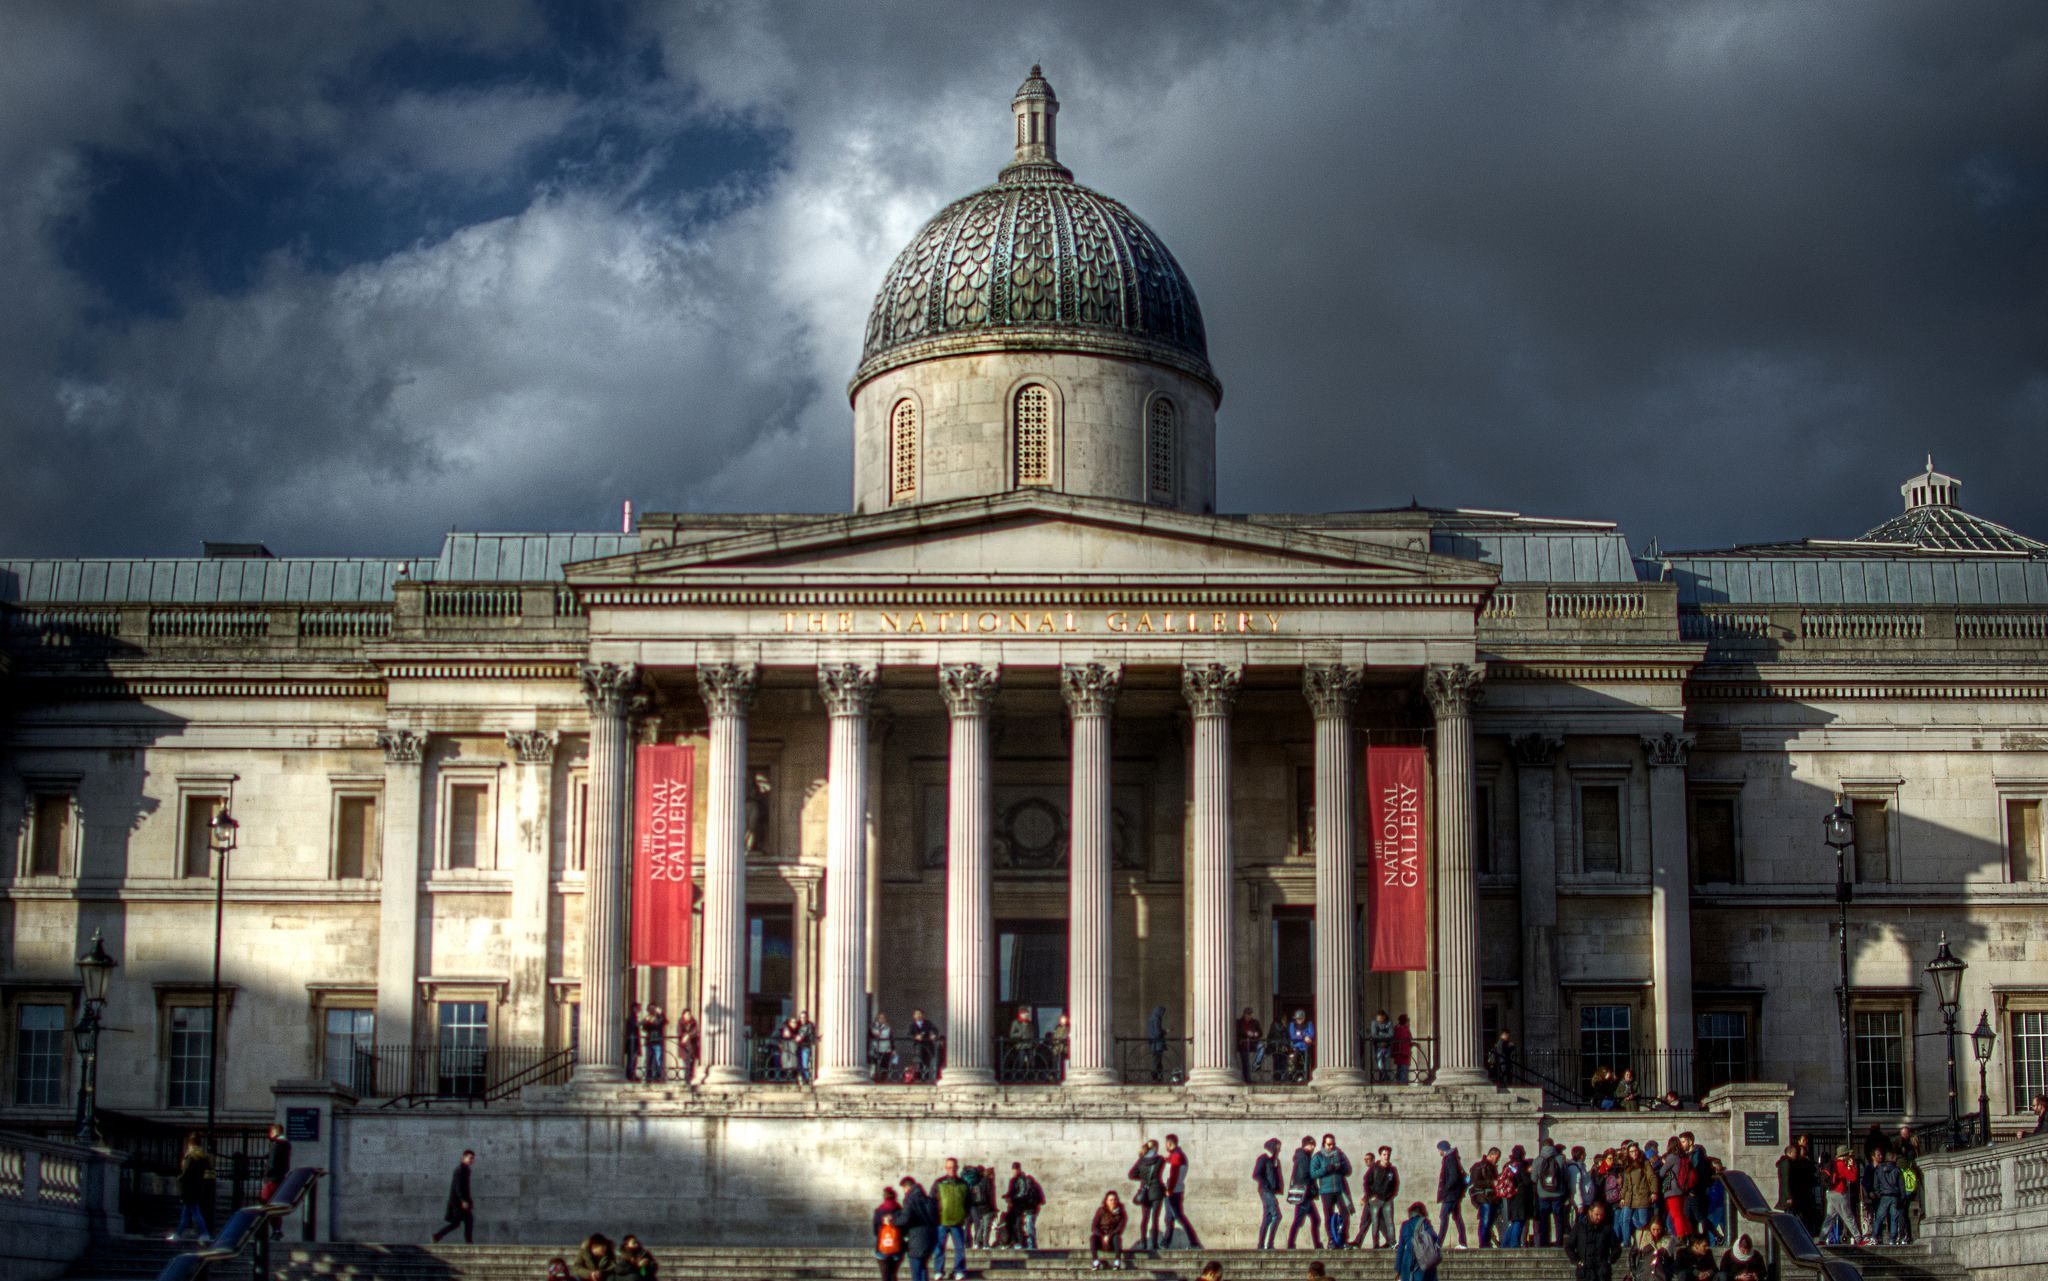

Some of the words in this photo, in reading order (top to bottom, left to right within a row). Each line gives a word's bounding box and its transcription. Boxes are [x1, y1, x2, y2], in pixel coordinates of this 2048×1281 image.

[779, 611, 854, 633] THE
[880, 611, 1081, 633] NATIONAL
[1106, 611, 1285, 633] GALLERY
[642, 834, 650, 853] THE
[650, 778, 669, 881] NATIONAL
[667, 779, 687, 882] GALLERY
[1375, 840, 1383, 859] THE
[1384, 783, 1399, 887] NATIONAL
[1400, 784, 1418, 888] GALLERY
